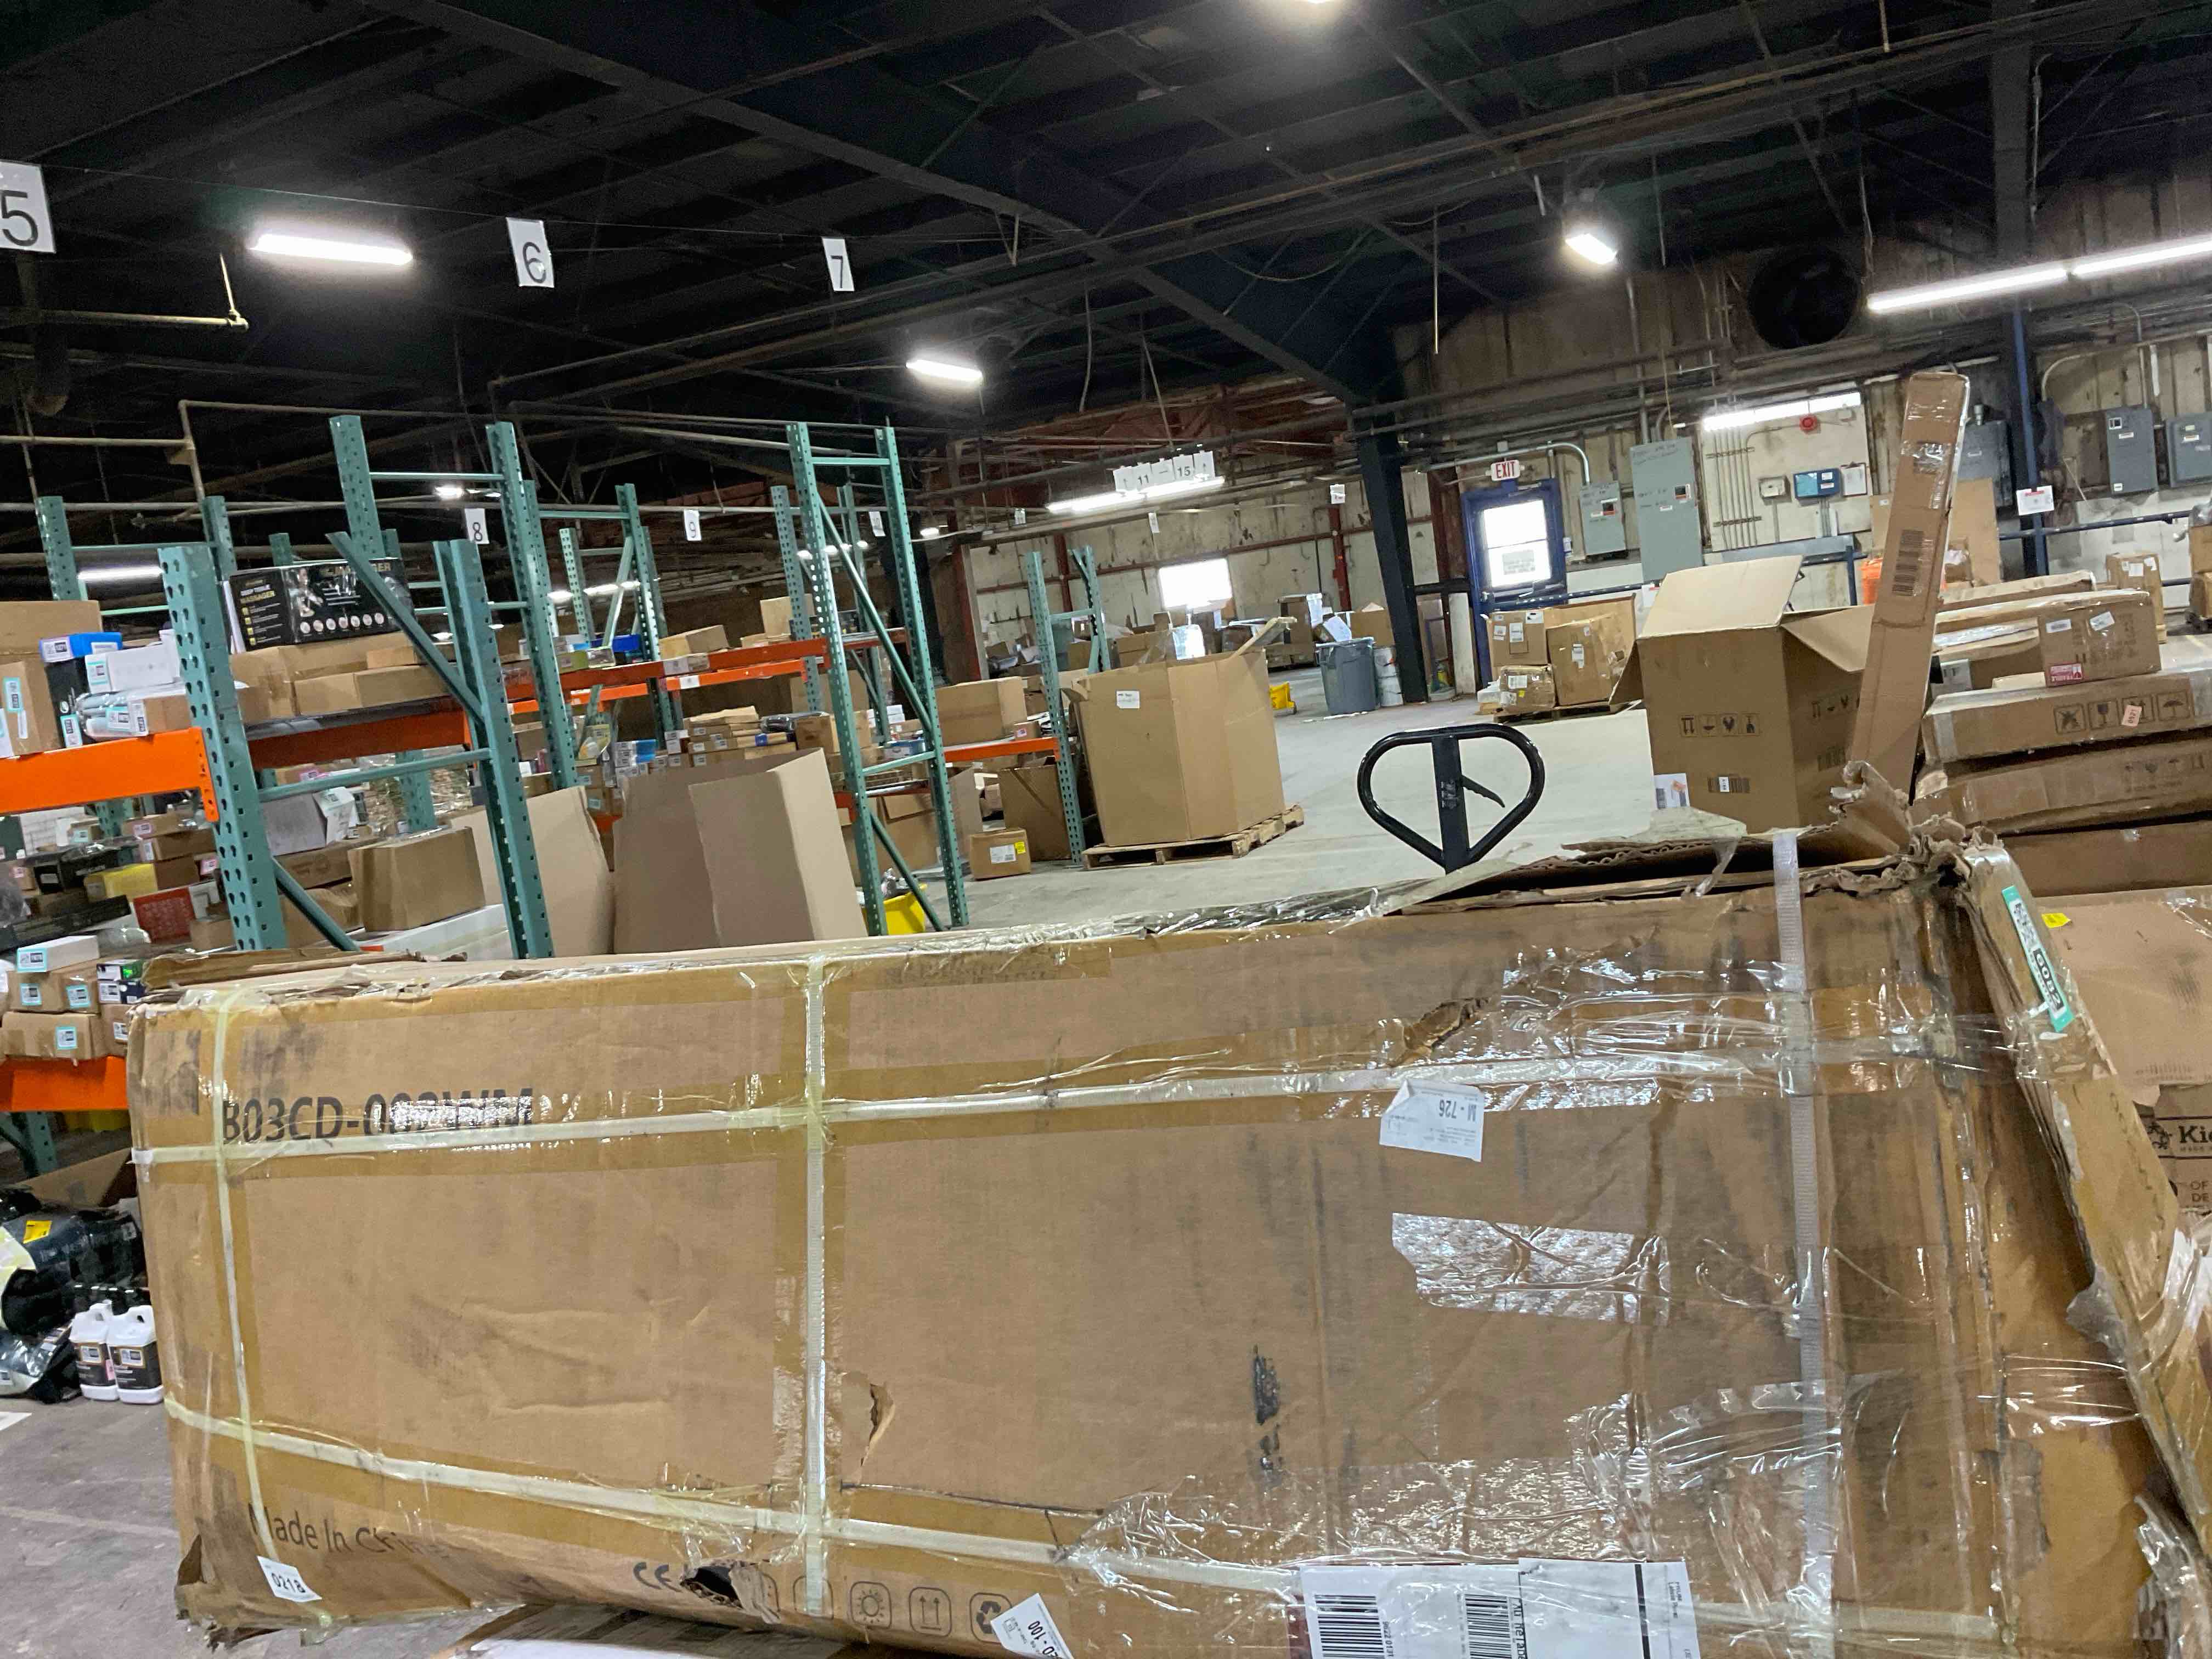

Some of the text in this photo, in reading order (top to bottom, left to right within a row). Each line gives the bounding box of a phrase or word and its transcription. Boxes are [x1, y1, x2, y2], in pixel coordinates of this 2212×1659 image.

[1, 190, 38, 246] 5
[522, 242, 547, 284] 6
[831, 255, 844, 289] 7
[1137, 474, 1149, 485] 11
[1177, 466, 1191, 477] 15
[1496, 461, 1515, 478] EXIT
[473, 522, 482, 541] 8
[689, 522, 697, 538] 9
[1439, 1099, 1457, 1119] 726
[324, 1519, 351, 1553] In
[1028, 1621, 1046, 1640] 100
